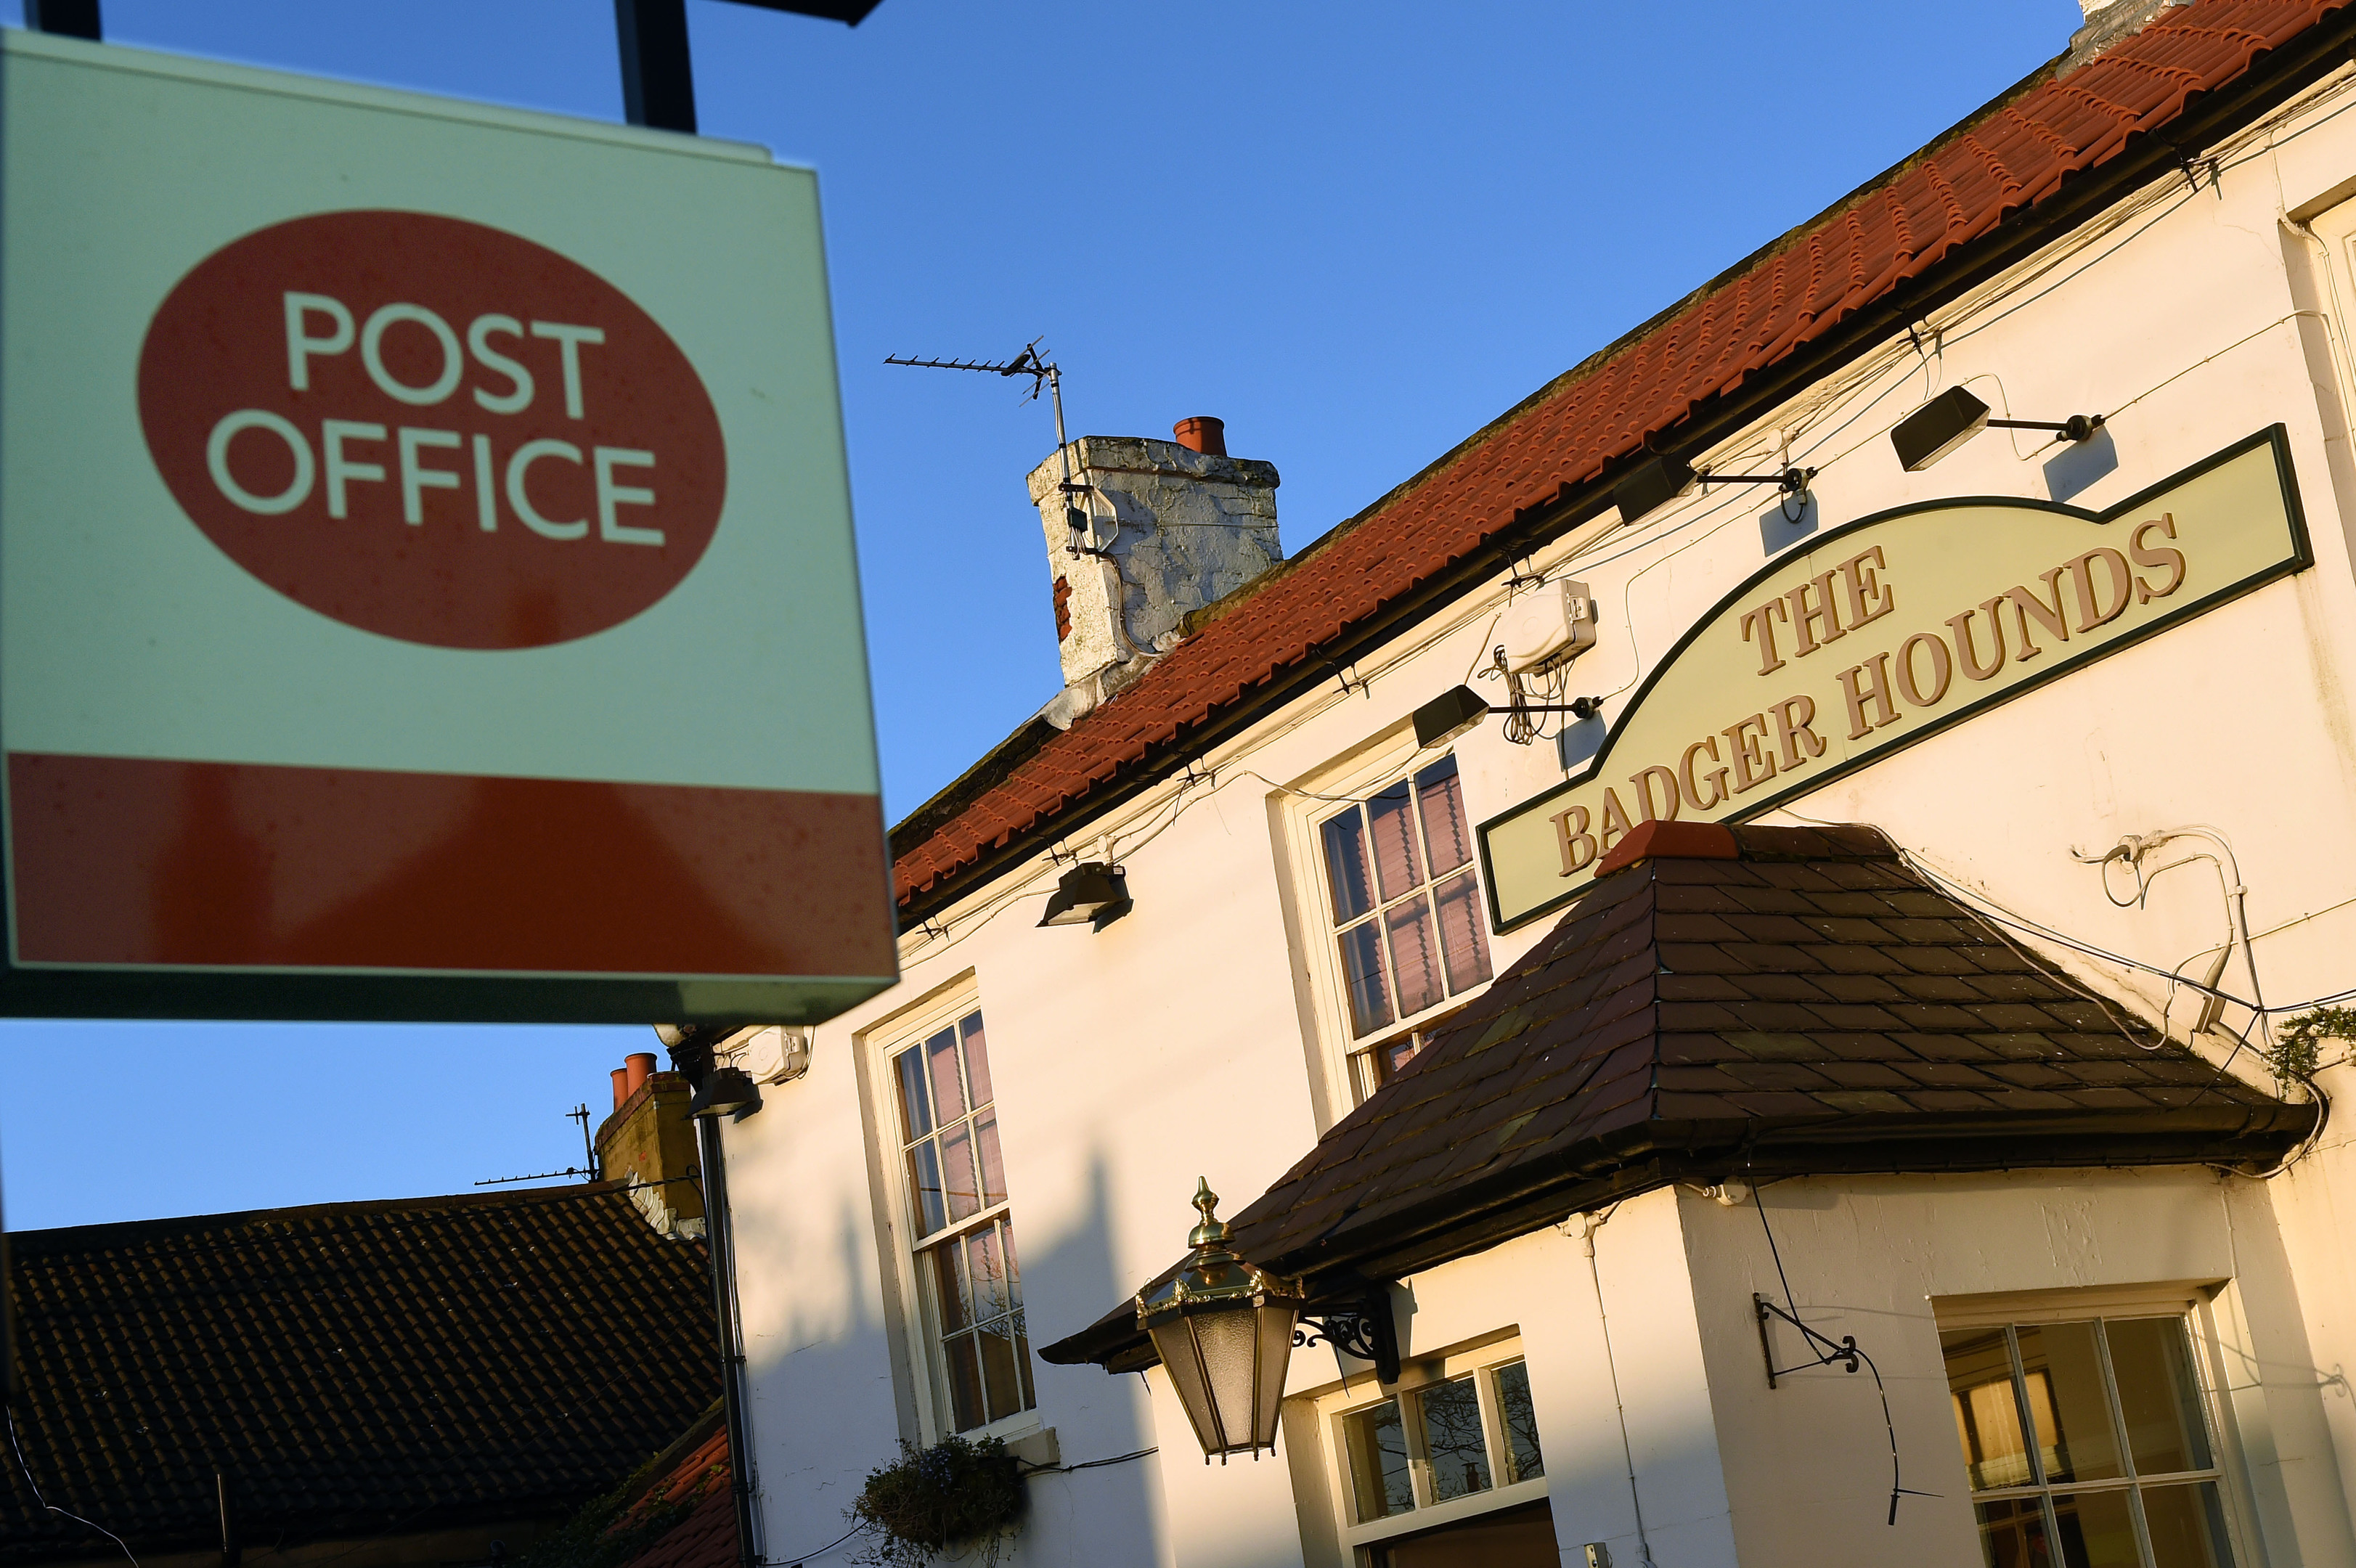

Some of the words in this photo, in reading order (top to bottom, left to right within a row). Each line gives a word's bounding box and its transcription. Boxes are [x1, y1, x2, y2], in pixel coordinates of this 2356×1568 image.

[284, 292, 605, 420] POST
[206, 409, 664, 545] OFFICE
[1740, 545, 1894, 677] THE
[1549, 695, 1827, 878] BADGER
[1836, 513, 2187, 741] HOUNDS
